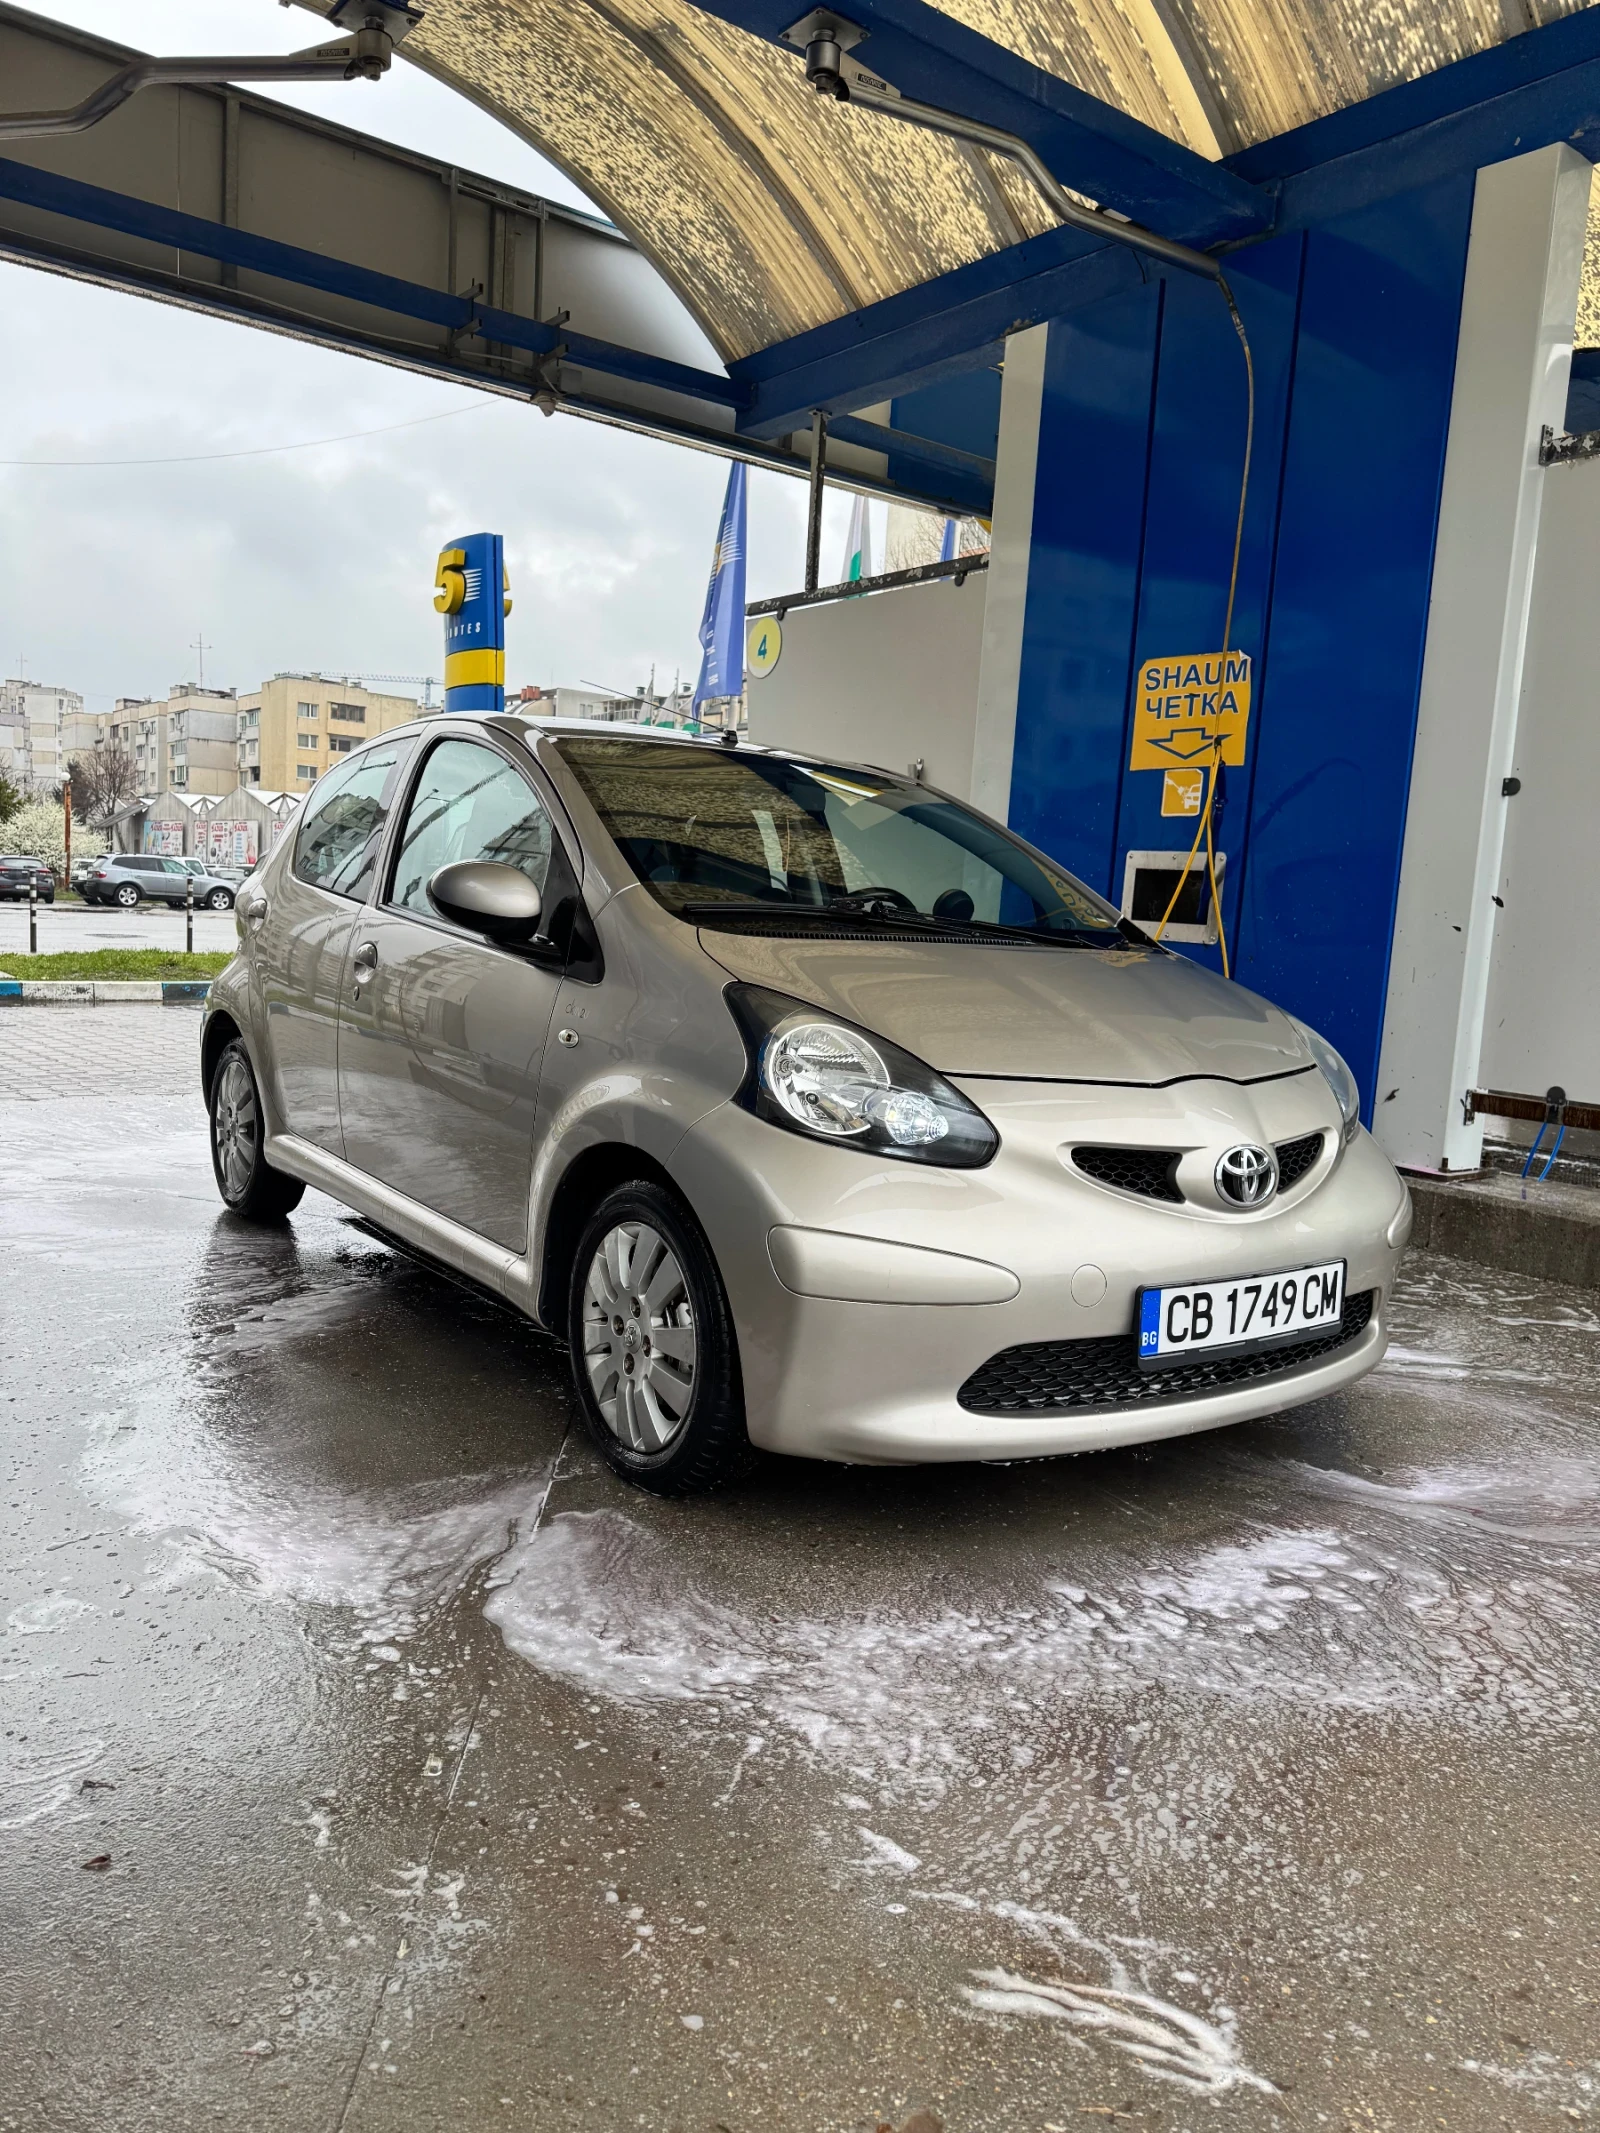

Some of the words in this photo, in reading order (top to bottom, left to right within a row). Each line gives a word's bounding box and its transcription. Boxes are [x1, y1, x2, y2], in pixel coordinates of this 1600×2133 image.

[433, 548, 466, 615] 5
[757, 633, 768, 660] 4
[1144, 658, 1248, 692] SHAUM
[1145, 690, 1239, 720] ЧЕТКА
[1166, 1291, 1213, 1344] CB
[1227, 1279, 1298, 1335] 1749
[1302, 1270, 1339, 1320] CM
[1141, 1330, 1157, 1347] BG
